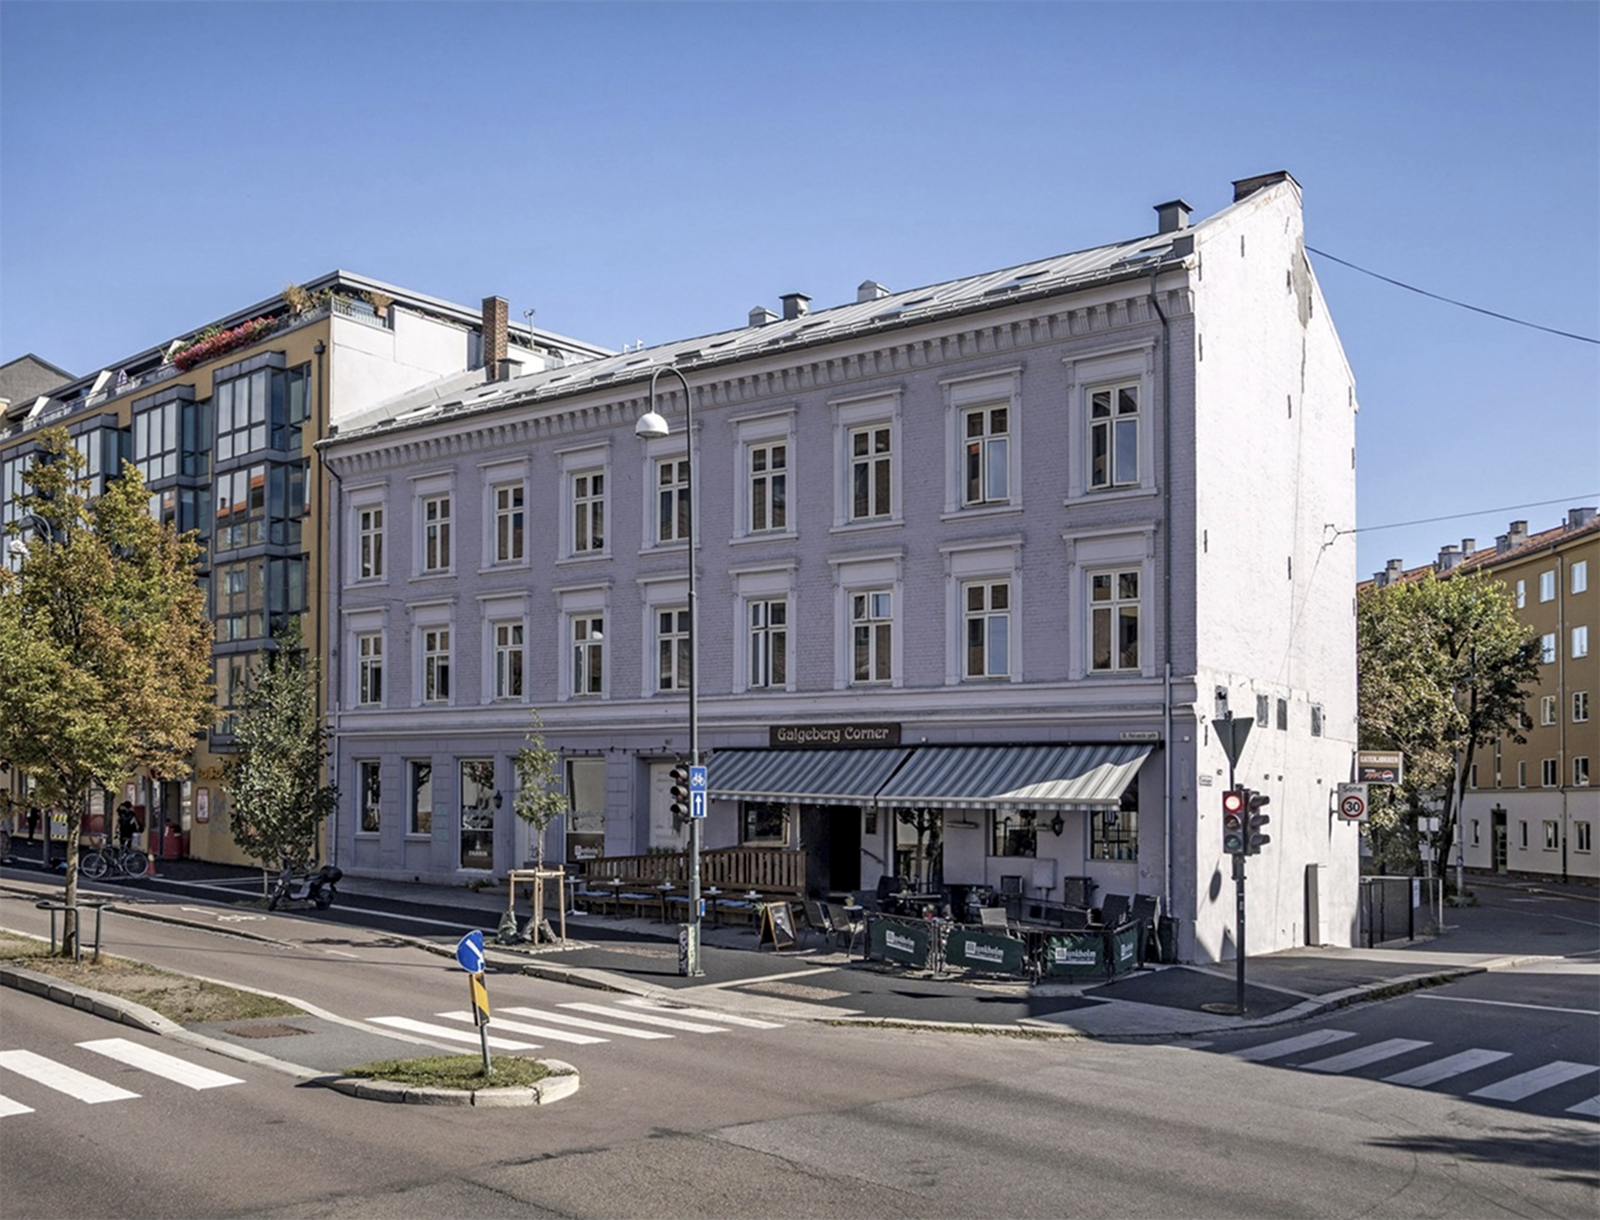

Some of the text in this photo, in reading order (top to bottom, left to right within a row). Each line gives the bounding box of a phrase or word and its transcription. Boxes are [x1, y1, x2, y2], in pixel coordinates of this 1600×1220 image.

[777, 725, 889, 744] Galgeberg Corner
[1343, 784, 1363, 793] Sone
[1346, 801, 1360, 813] 30
